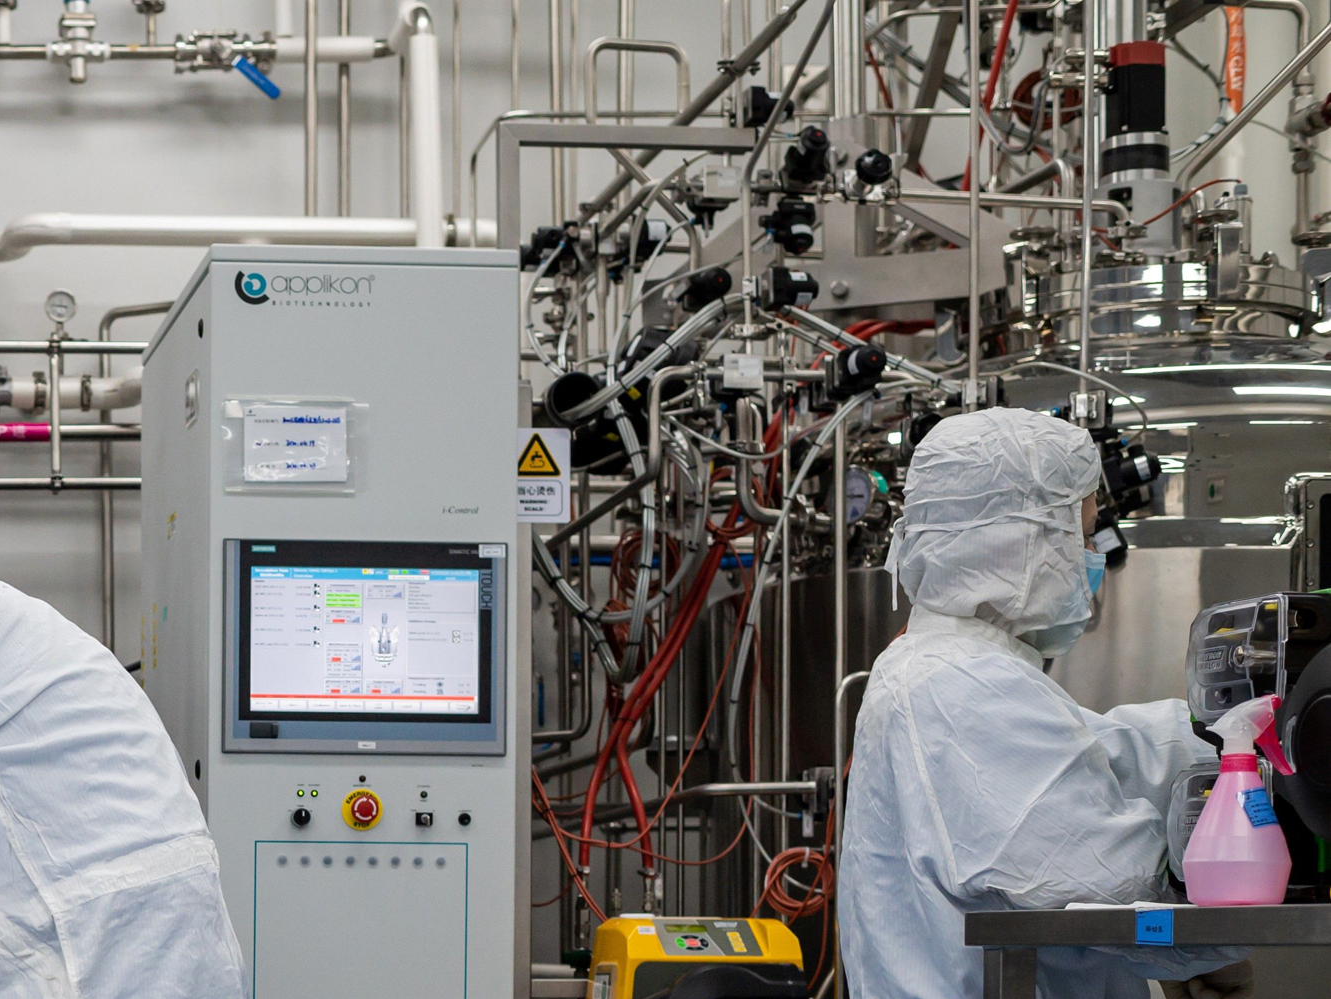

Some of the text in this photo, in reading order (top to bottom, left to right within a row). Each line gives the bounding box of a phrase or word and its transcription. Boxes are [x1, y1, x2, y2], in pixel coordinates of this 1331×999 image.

[272, 300, 371, 308] BIOTECHNOLOGY
[442, 505, 479, 515] i-Control
[481, 570, 492, 608] TOUCH
